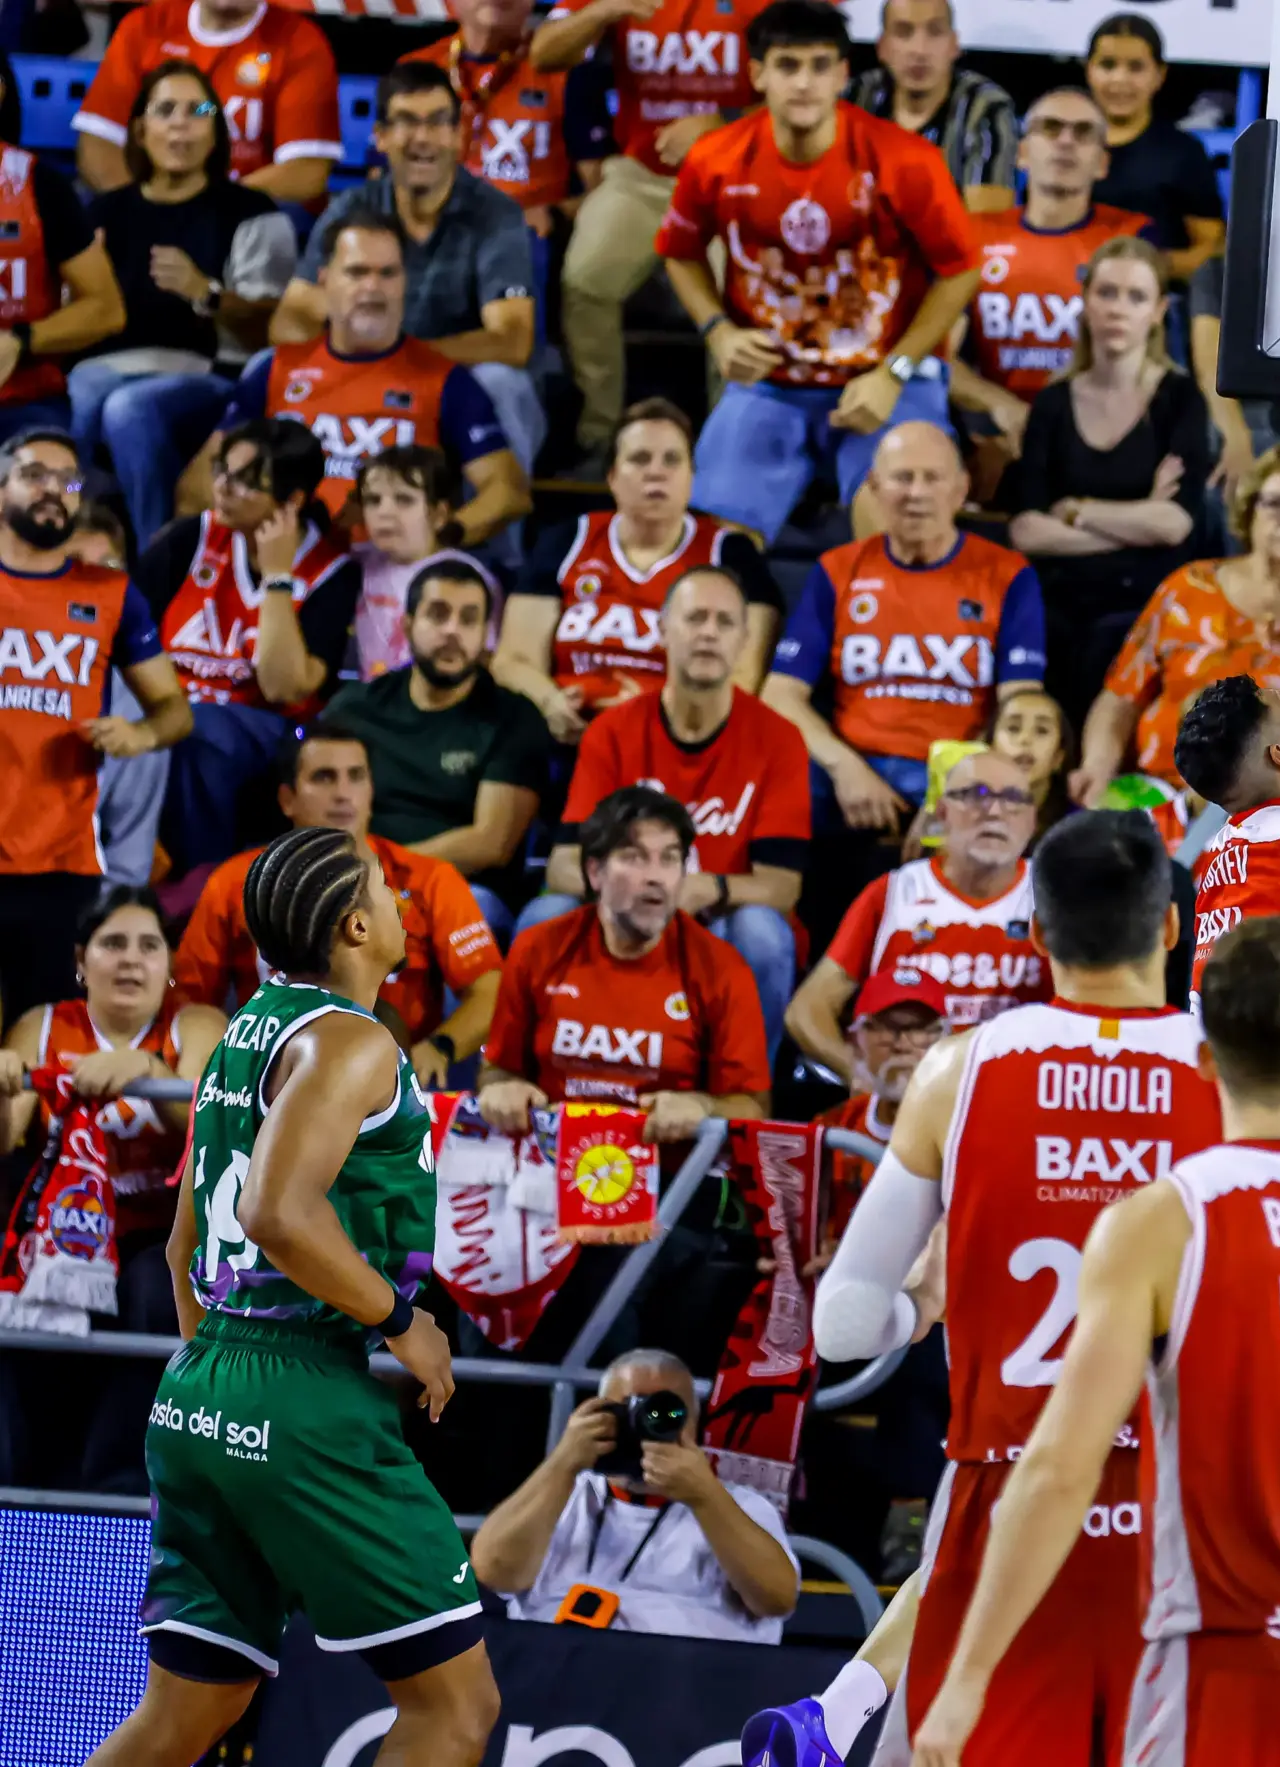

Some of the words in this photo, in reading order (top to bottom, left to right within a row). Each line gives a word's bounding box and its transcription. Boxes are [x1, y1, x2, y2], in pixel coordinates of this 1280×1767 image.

[627, 29, 740, 75] BAXI
[978, 292, 1085, 341] BAX
[274, 411, 415, 457] AXI
[556, 600, 664, 652] BAX
[0, 628, 99, 686] AXI
[841, 634, 996, 688] BAXI
[552, 1018, 663, 1069] BAXI
[1037, 1060, 1173, 1115] ORIOLA
[1035, 1134, 1173, 1182] BAXI
[1001, 1237, 1084, 1388] 2
[188, 1406, 222, 1440] del
[226, 1420, 271, 1450] sol
